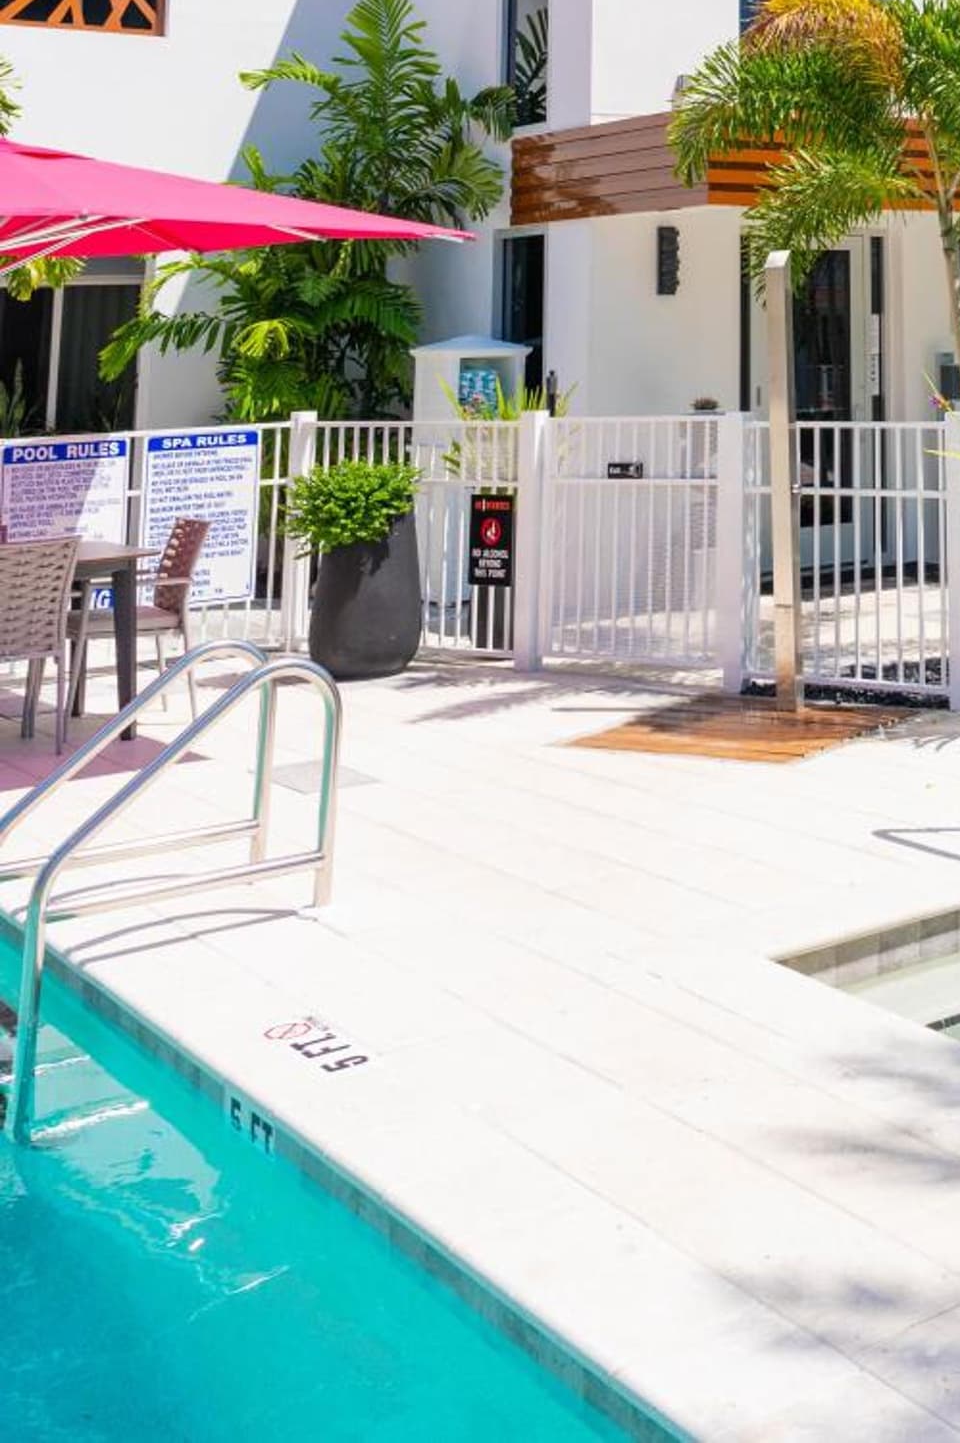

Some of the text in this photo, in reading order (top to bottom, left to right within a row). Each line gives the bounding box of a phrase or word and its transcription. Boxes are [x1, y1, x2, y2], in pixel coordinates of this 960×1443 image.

[162, 434, 247, 449] SPA RULES
[12, 442, 120, 462] POOL RULES
[320, 1055, 368, 1072] 5
[230, 1096, 273, 1154] 5 FT
